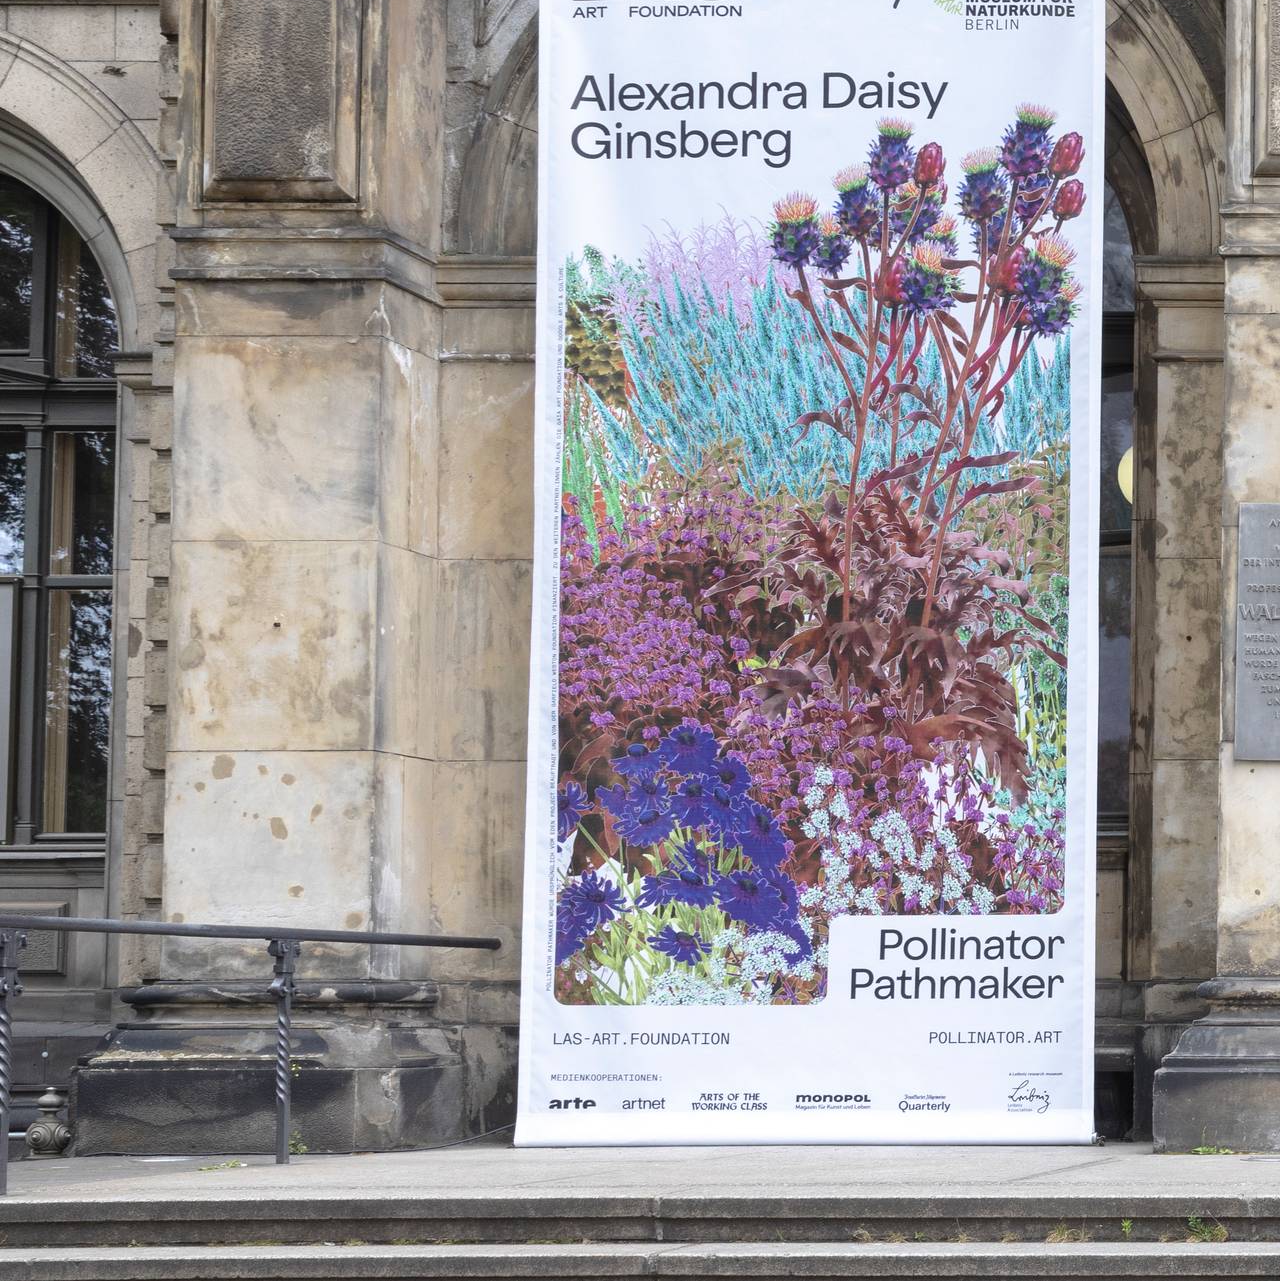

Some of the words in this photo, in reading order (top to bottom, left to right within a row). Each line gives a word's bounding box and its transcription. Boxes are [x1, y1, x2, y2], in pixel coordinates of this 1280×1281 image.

[573, 6, 607, 18] ART
[629, 5, 742, 18] FOUNDATION
[965, 5, 1075, 17] NATURKUNDE
[965, 19, 1019, 30] BERLIN
[570, 71, 807, 112] Alexandra
[822, 71, 949, 119] Daisy
[571, 120, 792, 169] Ginsberg
[879, 928, 1065, 960] Pollinator
[850, 967, 1065, 1000] Pathmaker
[553, 1032, 730, 1045] LAS-ART.FOUNDATION
[929, 1031, 1063, 1044] POLLINATOR.ART
[551, 1074, 662, 1082] MEDIENKOOPERATIONEN:
[549, 1097, 597, 1109] arte
[622, 1097, 666, 1110] artnet
[699, 1093, 724, 1101] ARTS
[727, 1093, 740, 1101] OF
[744, 1093, 760, 1101] THE
[692, 1102, 737, 1111] WORKING
[741, 1102, 768, 1111] CLASS
[899, 1101, 950, 1112] Quarterly
